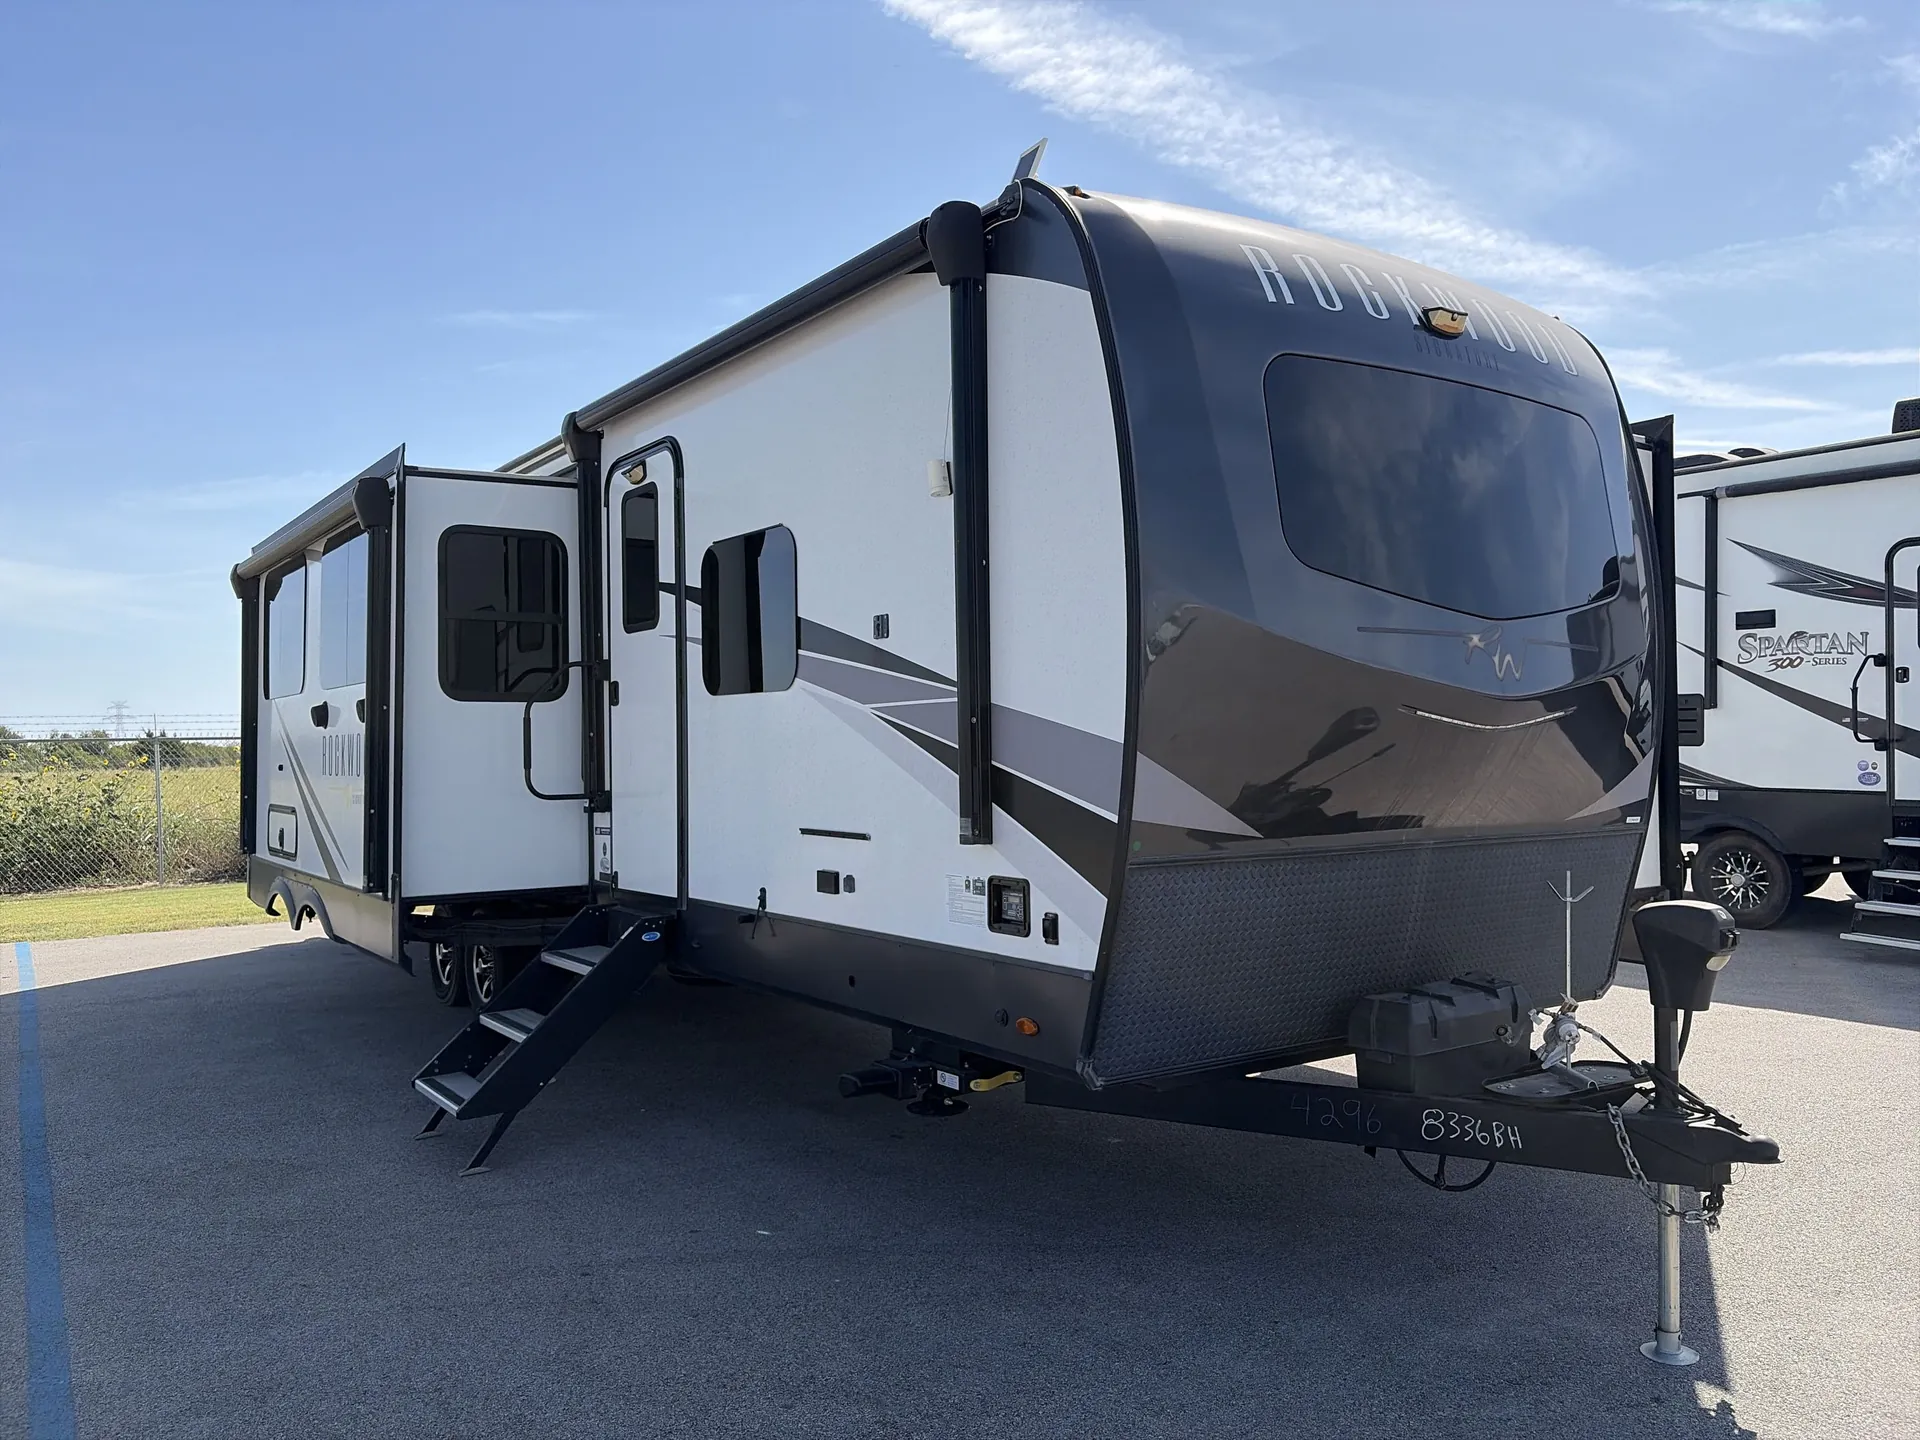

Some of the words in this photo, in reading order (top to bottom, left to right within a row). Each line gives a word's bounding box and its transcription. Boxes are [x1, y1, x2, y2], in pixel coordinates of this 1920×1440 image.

[1738, 630, 1869, 664] SPARTAN
[322, 733, 361, 777] ROCKWO
[1291, 1094, 1382, 1134] 4296
[1421, 1108, 1522, 1149] 8336BH
